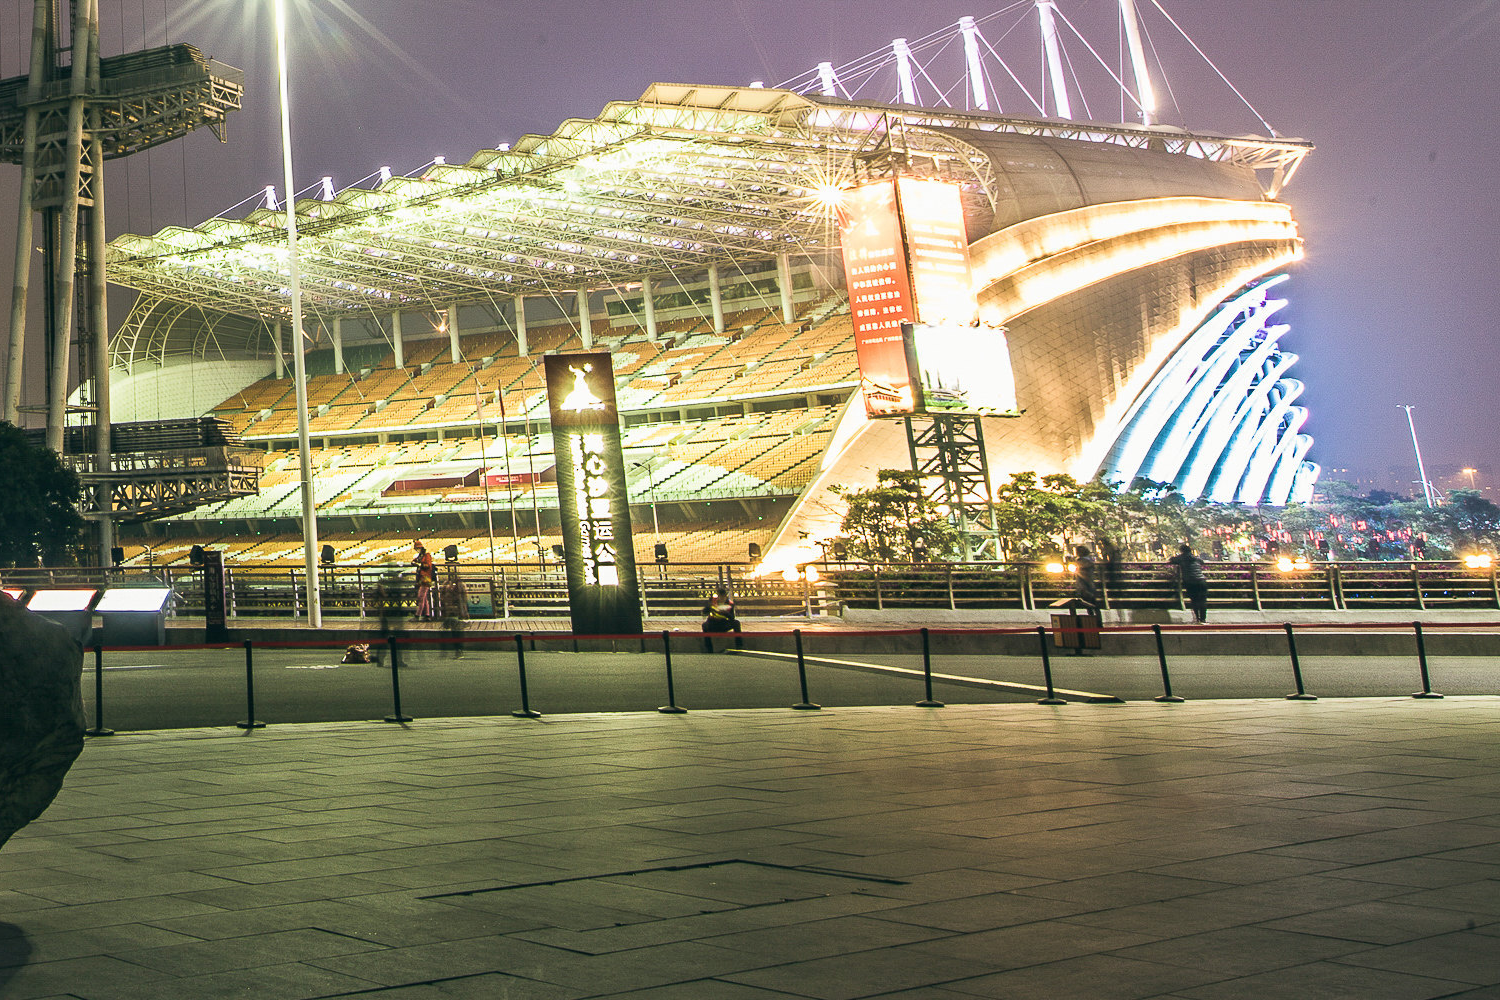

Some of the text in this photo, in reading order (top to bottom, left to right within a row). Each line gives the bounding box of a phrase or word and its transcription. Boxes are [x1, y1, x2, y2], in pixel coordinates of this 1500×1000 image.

[579, 520, 593, 558] Games
[583, 433, 619, 586] 心沙亚运公
